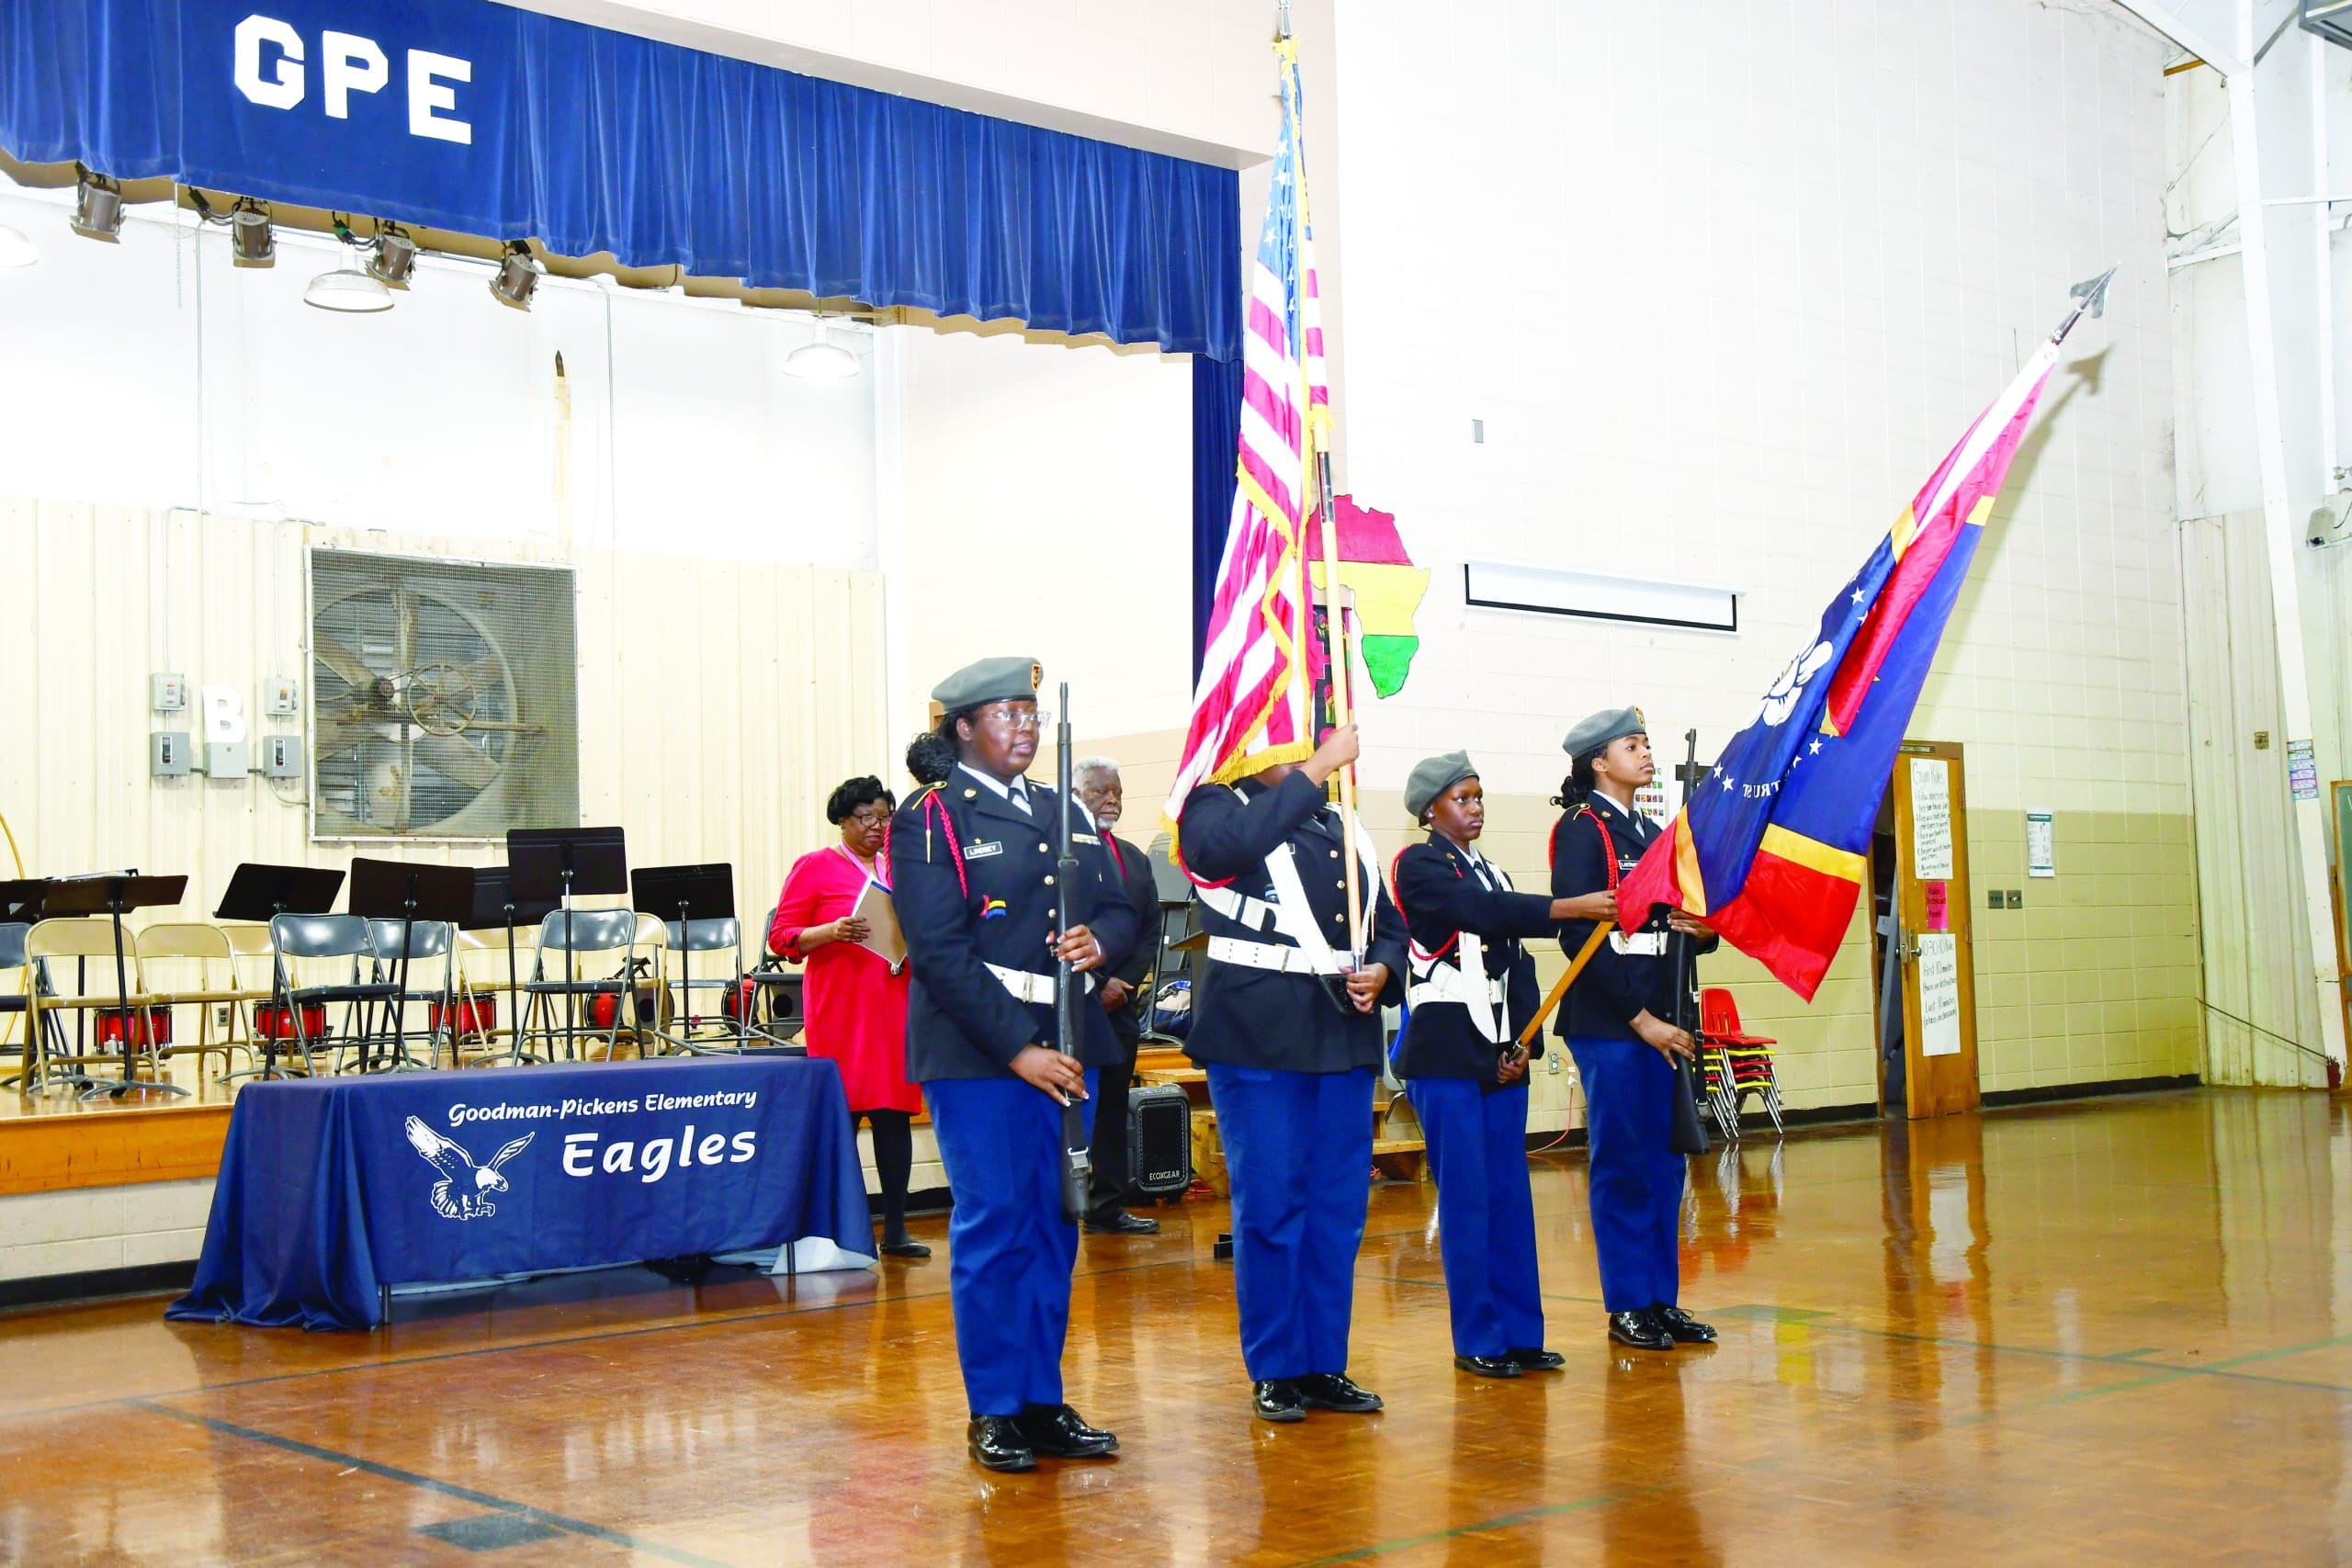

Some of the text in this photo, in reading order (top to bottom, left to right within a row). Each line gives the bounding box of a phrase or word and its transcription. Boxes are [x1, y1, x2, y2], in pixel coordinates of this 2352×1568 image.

[234, 14, 471, 145] GPE
[202, 685, 246, 743] B
[448, 1090, 757, 1126] Goodman-Pickens Elementary
[562, 1124, 757, 1183] Eagles
[1149, 1170, 1180, 1180] ECOXGEAR
